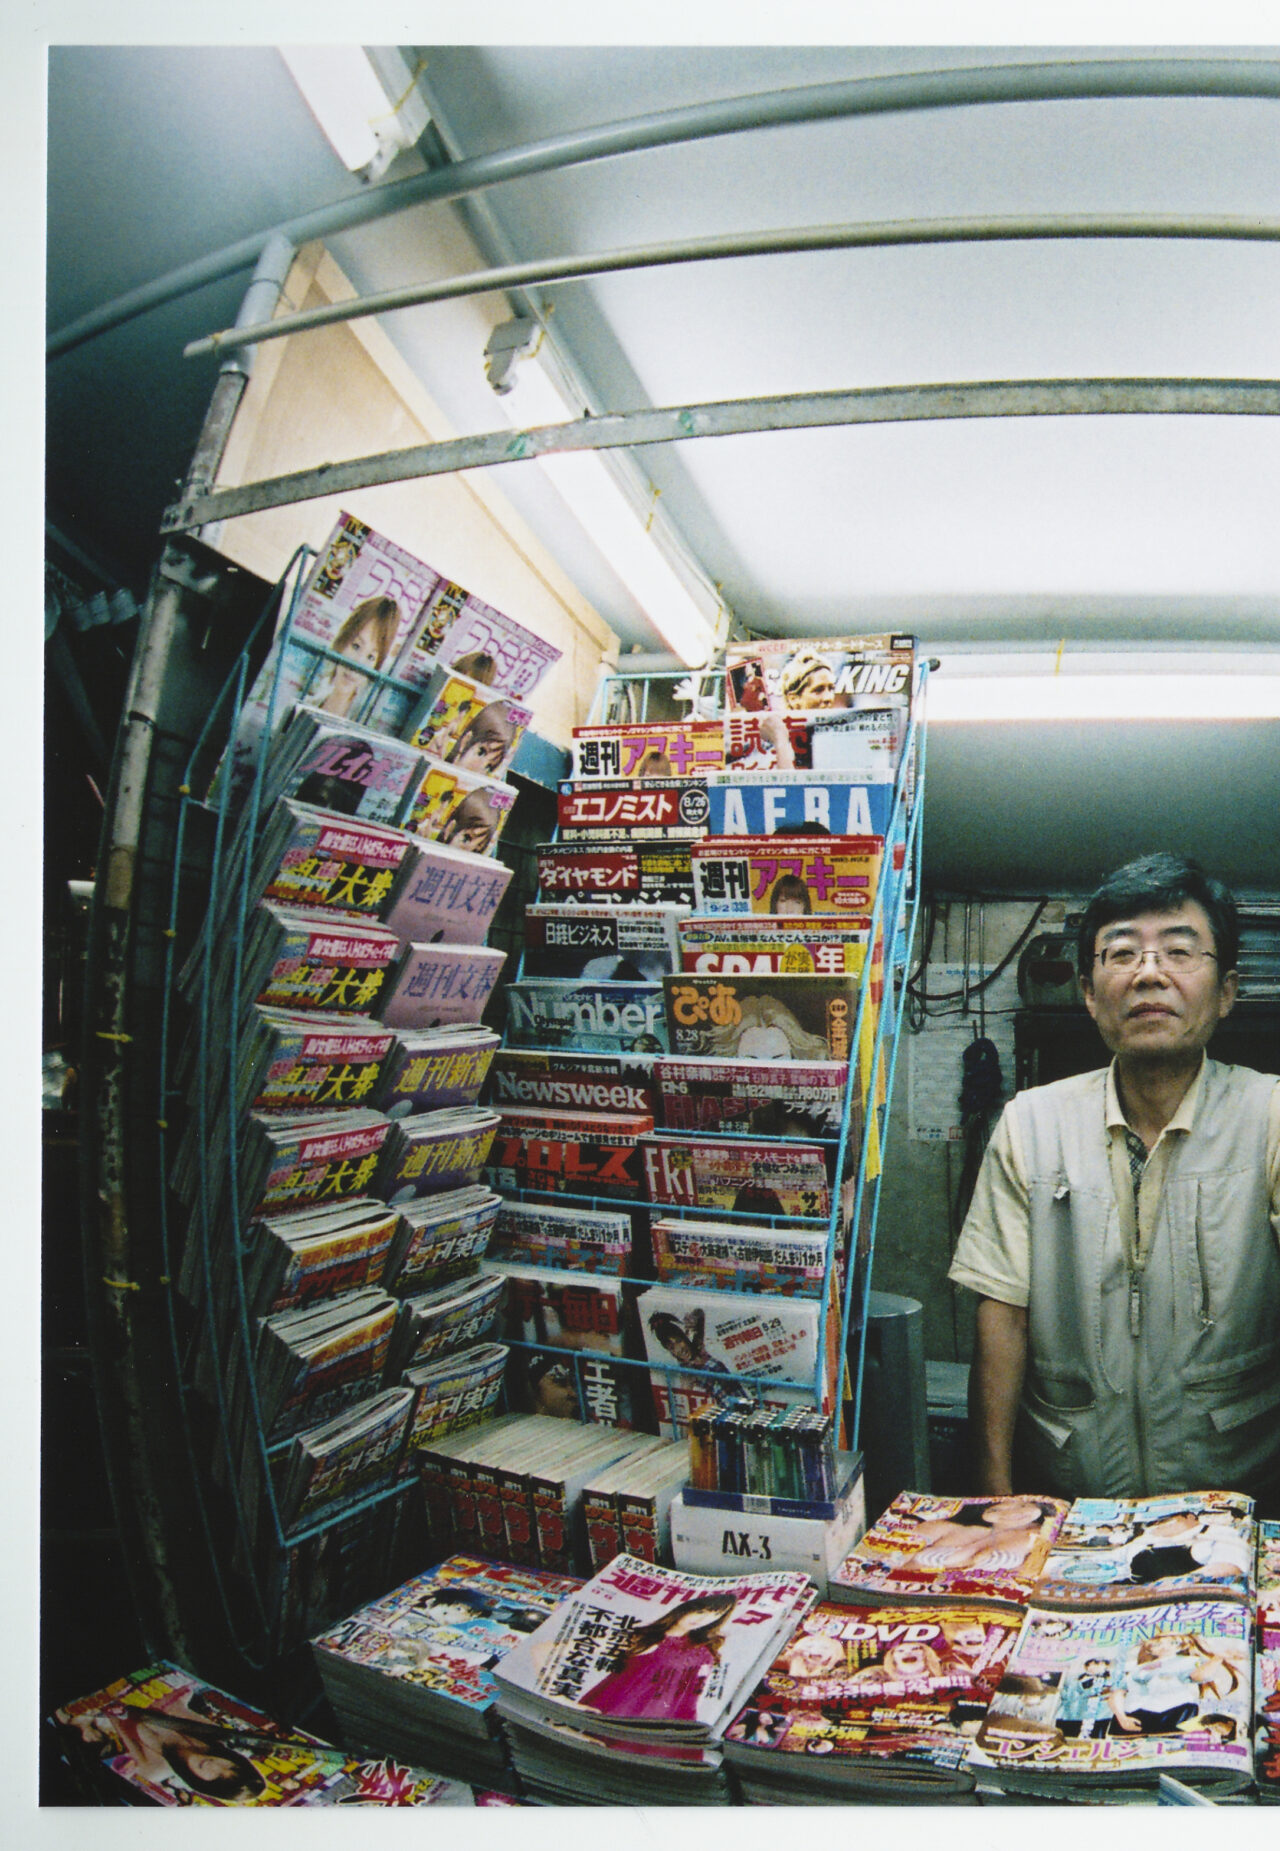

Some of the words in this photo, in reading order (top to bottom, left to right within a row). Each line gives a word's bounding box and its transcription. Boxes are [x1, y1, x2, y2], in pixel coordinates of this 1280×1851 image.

[836, 663, 911, 695] KING
[579, 739, 621, 776] 週刊
[570, 794, 673, 823] エコノミスト
[723, 786, 875, 835] AERA
[407, 865, 504, 918] 週刊文春
[540, 865, 638, 888] ダイヤモンド
[700, 860, 750, 899] 週刊
[545, 921, 615, 947] 日経ビジネス
[403, 961, 498, 1000] 週刊文春
[509, 984, 662, 1036] Number
[670, 984, 743, 1026] ぴあ
[496, 1071, 648, 1110] Newsweek
[722, 1529, 771, 1561] AX-3
[838, 1622, 942, 1642] DVD
[551, 1604, 617, 1700] 不都合な真実
